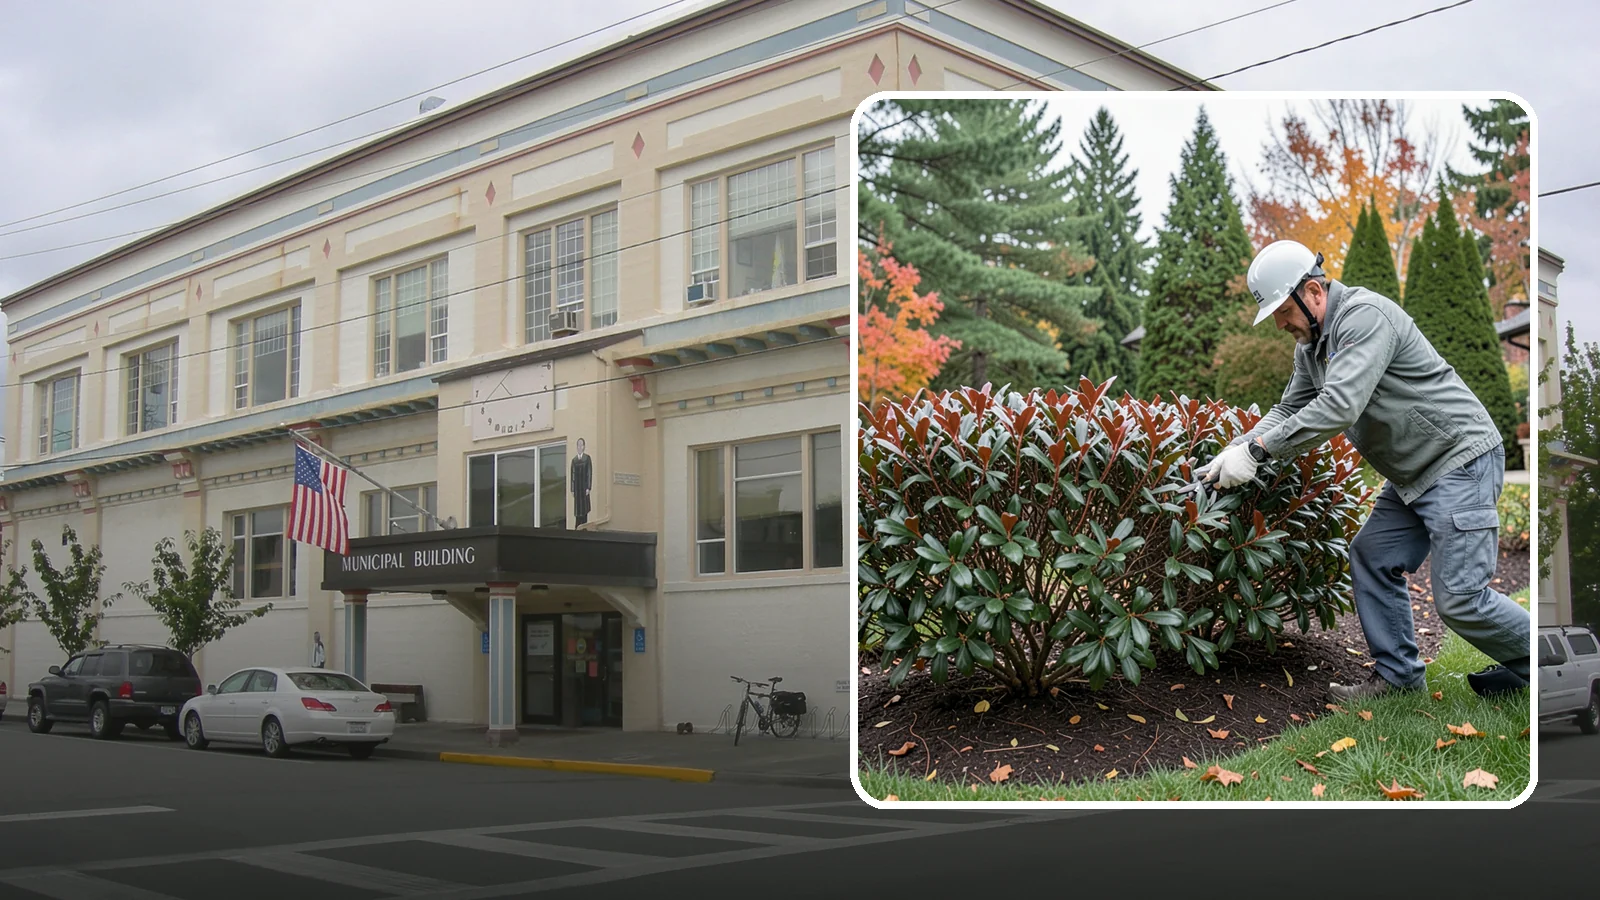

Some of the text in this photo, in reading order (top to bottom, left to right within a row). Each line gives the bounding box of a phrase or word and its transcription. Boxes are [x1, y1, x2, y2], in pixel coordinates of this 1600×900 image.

[536, 402, 540, 410] 4
[481, 407, 485, 415] 8
[488, 417, 492, 426] 9
[529, 414, 533, 422] 3
[494, 423, 500, 432] 10
[521, 420, 526, 428] 2
[507, 425, 514, 434] 12
[342, 546, 475, 572] MUNICIPAL BUILDING
